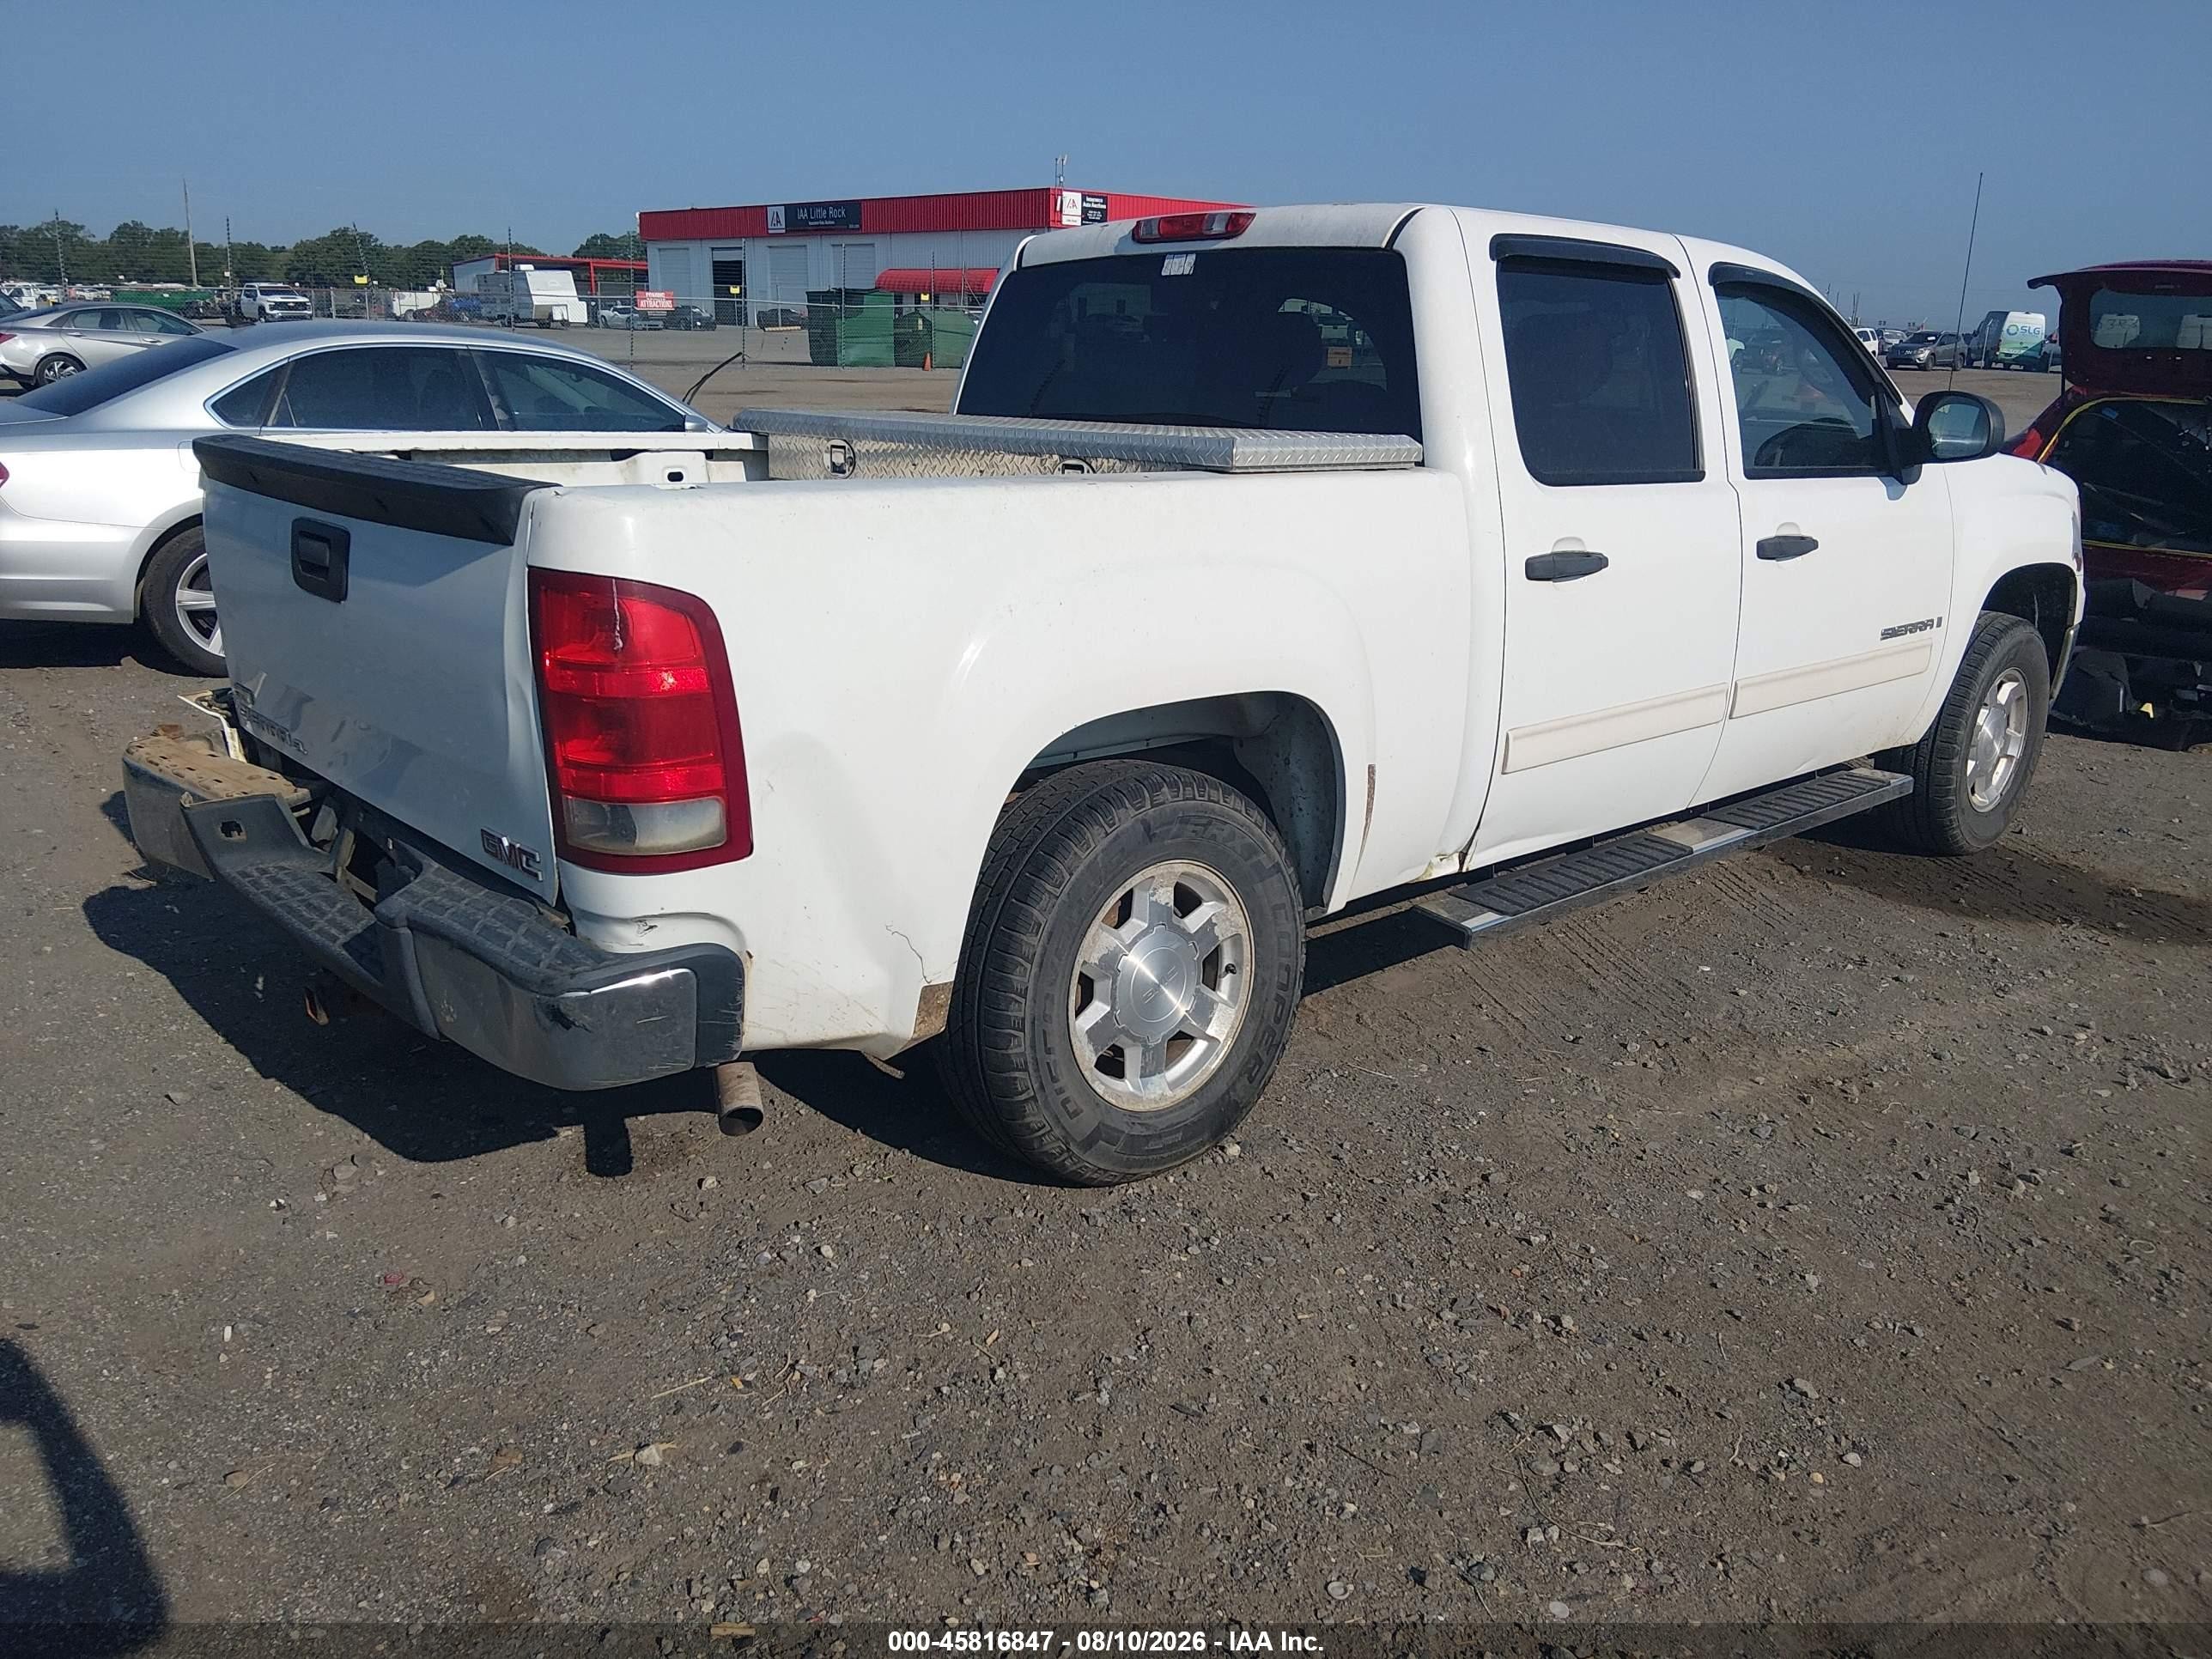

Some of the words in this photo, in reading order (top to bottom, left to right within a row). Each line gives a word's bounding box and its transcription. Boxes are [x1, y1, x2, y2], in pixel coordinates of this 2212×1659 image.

[797, 206, 808, 219] IAA
[810, 207, 826, 219] Little
[829, 206, 846, 218] Rock
[640, 300, 673, 308] ATTRACTIONS
[1880, 618, 1934, 641] SIERRA
[481, 829, 543, 882] GMC
